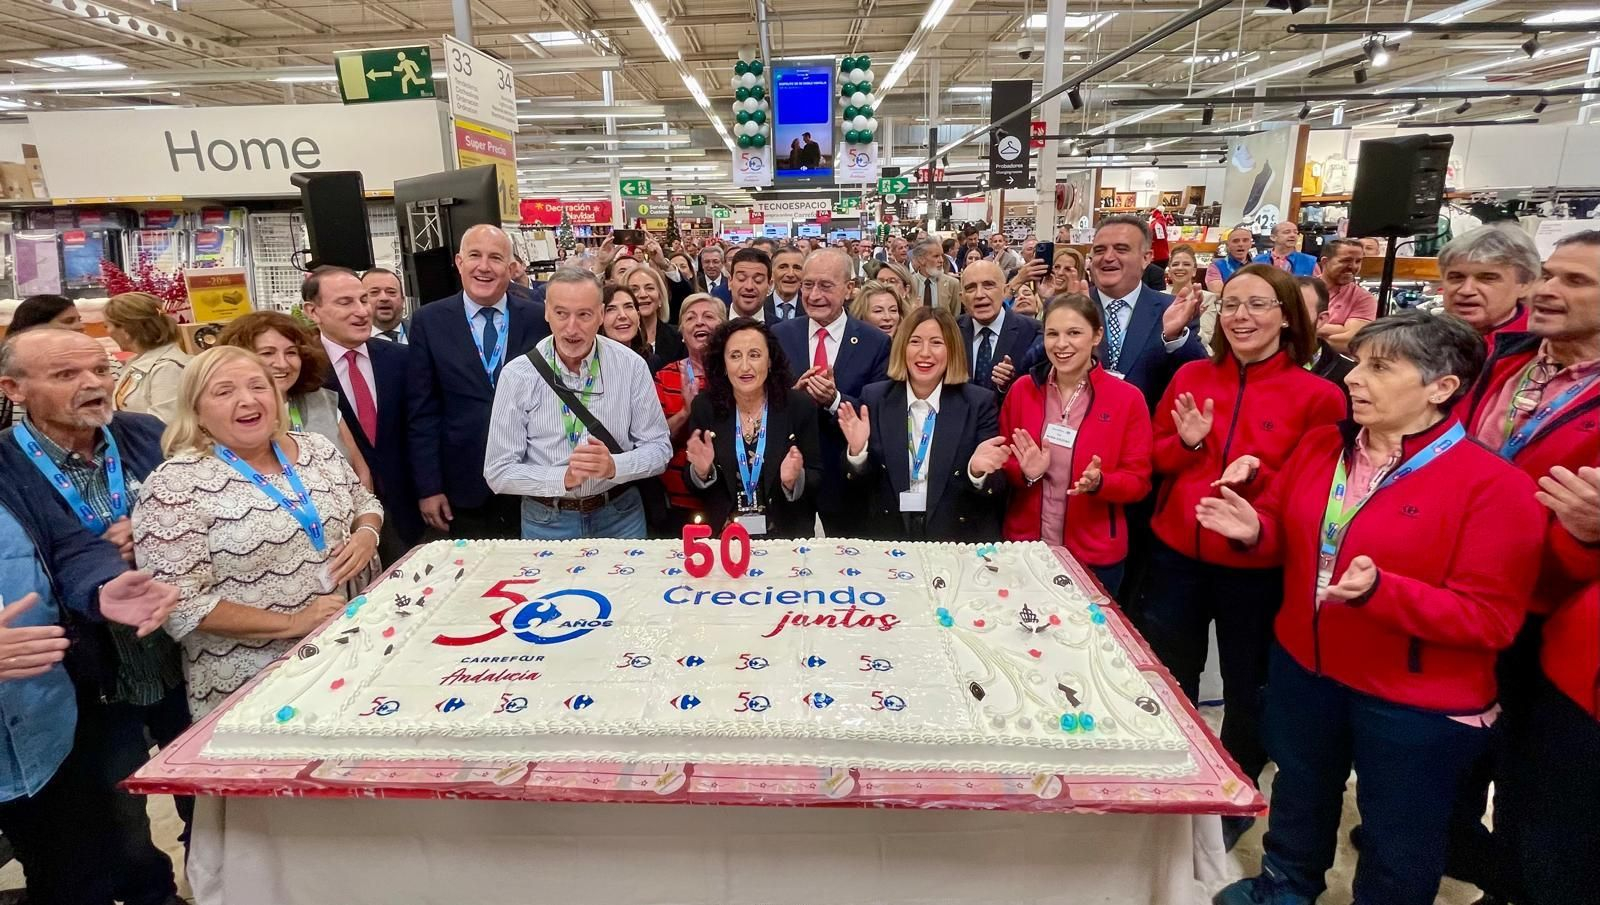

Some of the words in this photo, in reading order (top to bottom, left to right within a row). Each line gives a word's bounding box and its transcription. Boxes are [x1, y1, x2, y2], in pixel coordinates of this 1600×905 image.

[452, 48, 472, 76] 33
[497, 68, 512, 93] 34
[164, 130, 321, 172] Home
[465, 135, 487, 151] Super
[487, 141, 507, 156] Precio
[567, 211, 595, 220] Navidad
[758, 201, 827, 211] TECNOESPACIO
[682, 522, 751, 579] 50
[663, 585, 887, 607] Creciendo
[431, 578, 612, 646] 50
[557, 618, 614, 629] AÑOS
